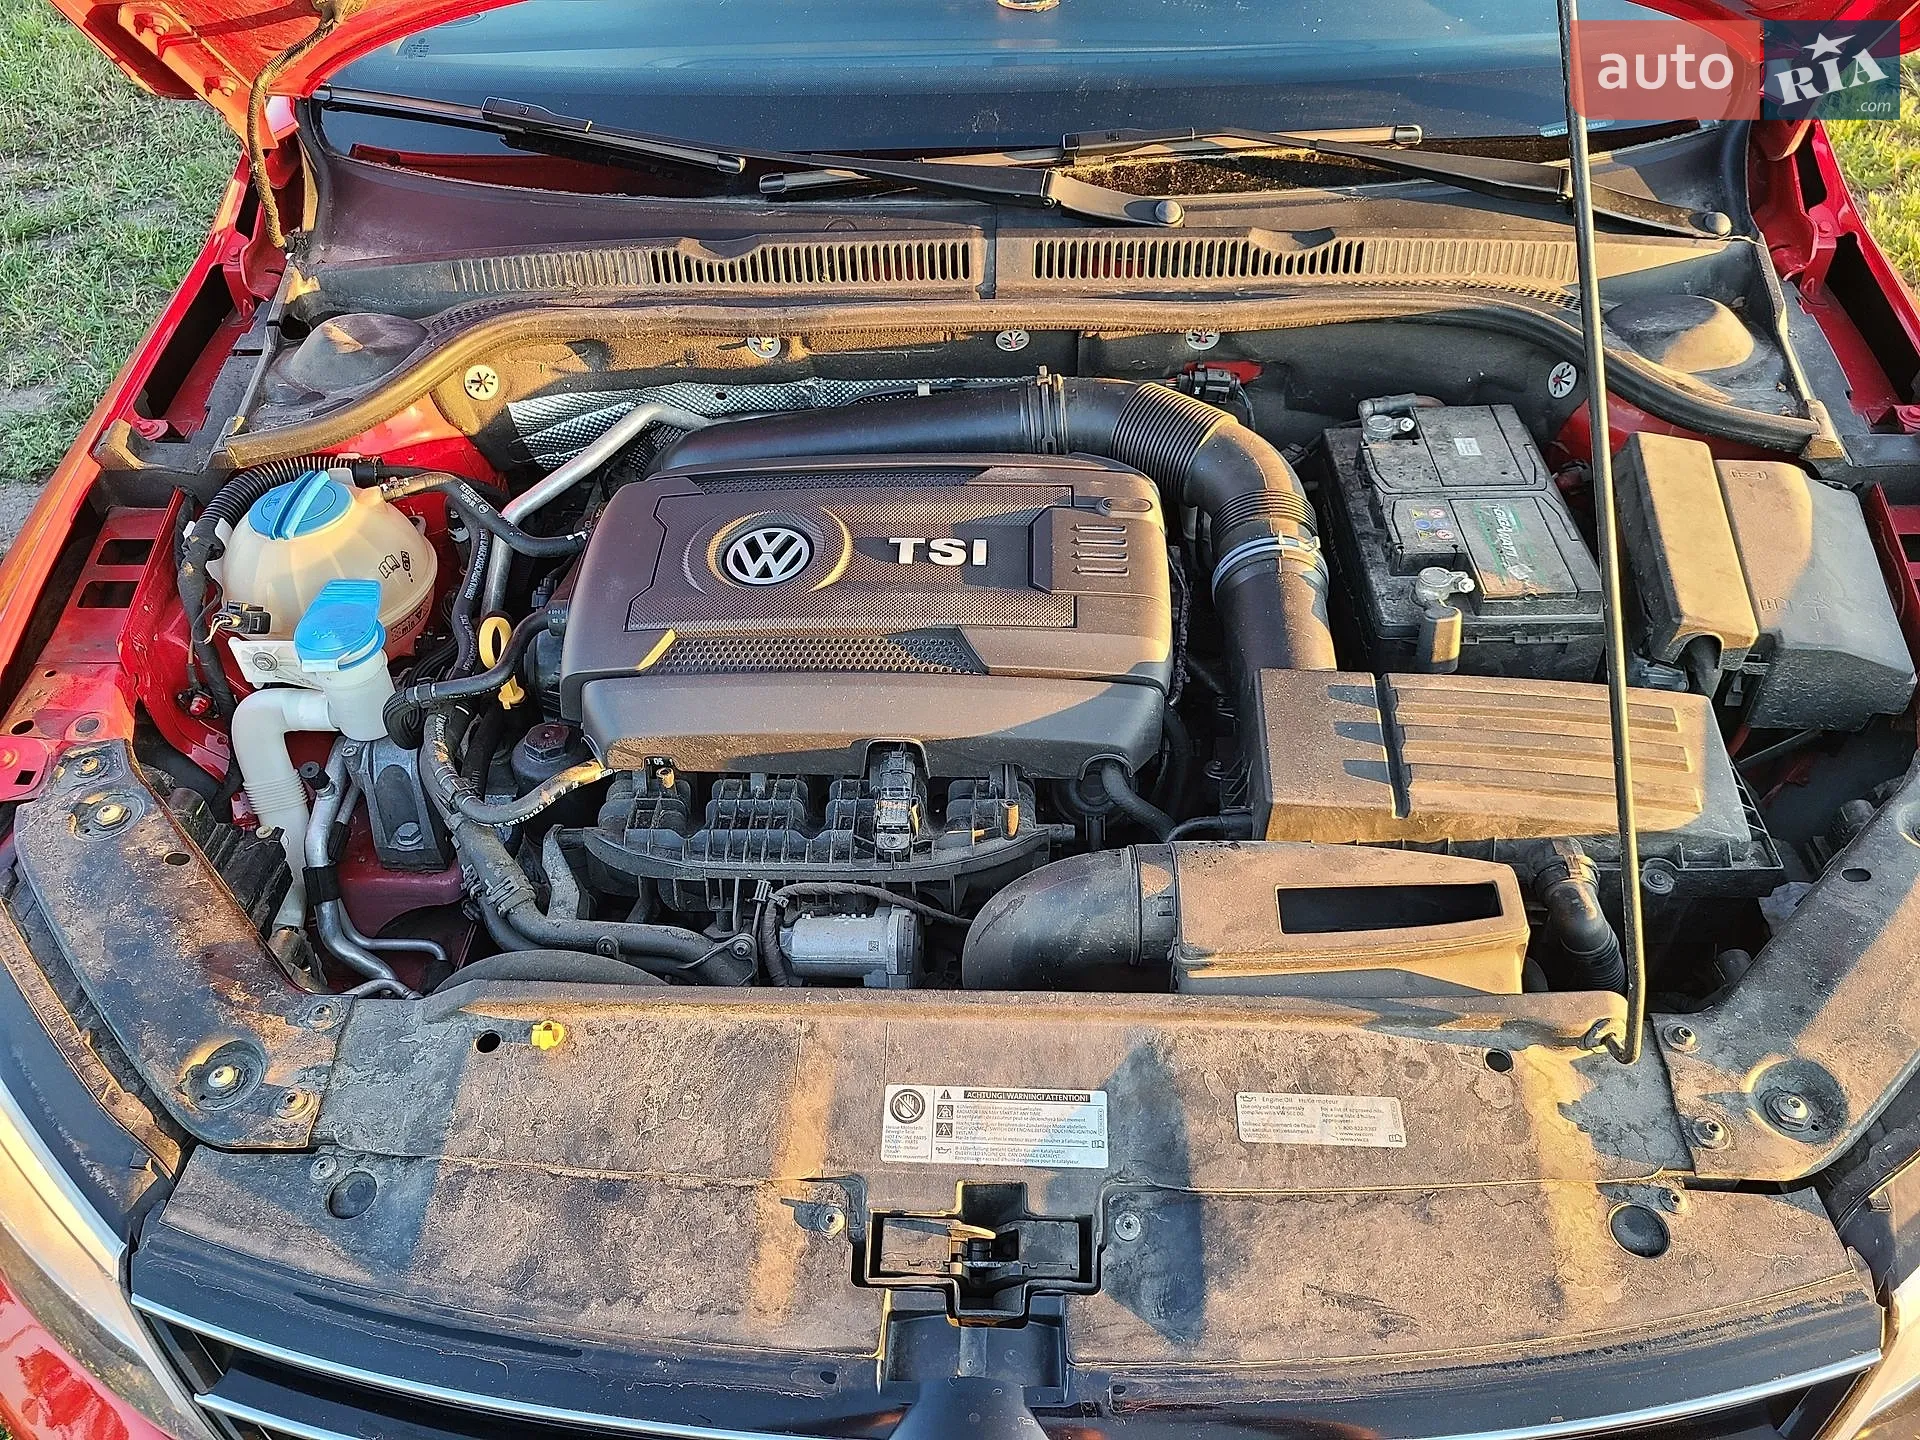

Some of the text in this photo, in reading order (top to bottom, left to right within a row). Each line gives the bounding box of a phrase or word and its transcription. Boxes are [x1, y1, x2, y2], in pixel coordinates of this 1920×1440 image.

[888, 537, 988, 566] TSI
[401, 620, 416, 634] min
[966, 1091, 1088, 1102] ACHTUNG! WARNING! ATTENTION!
